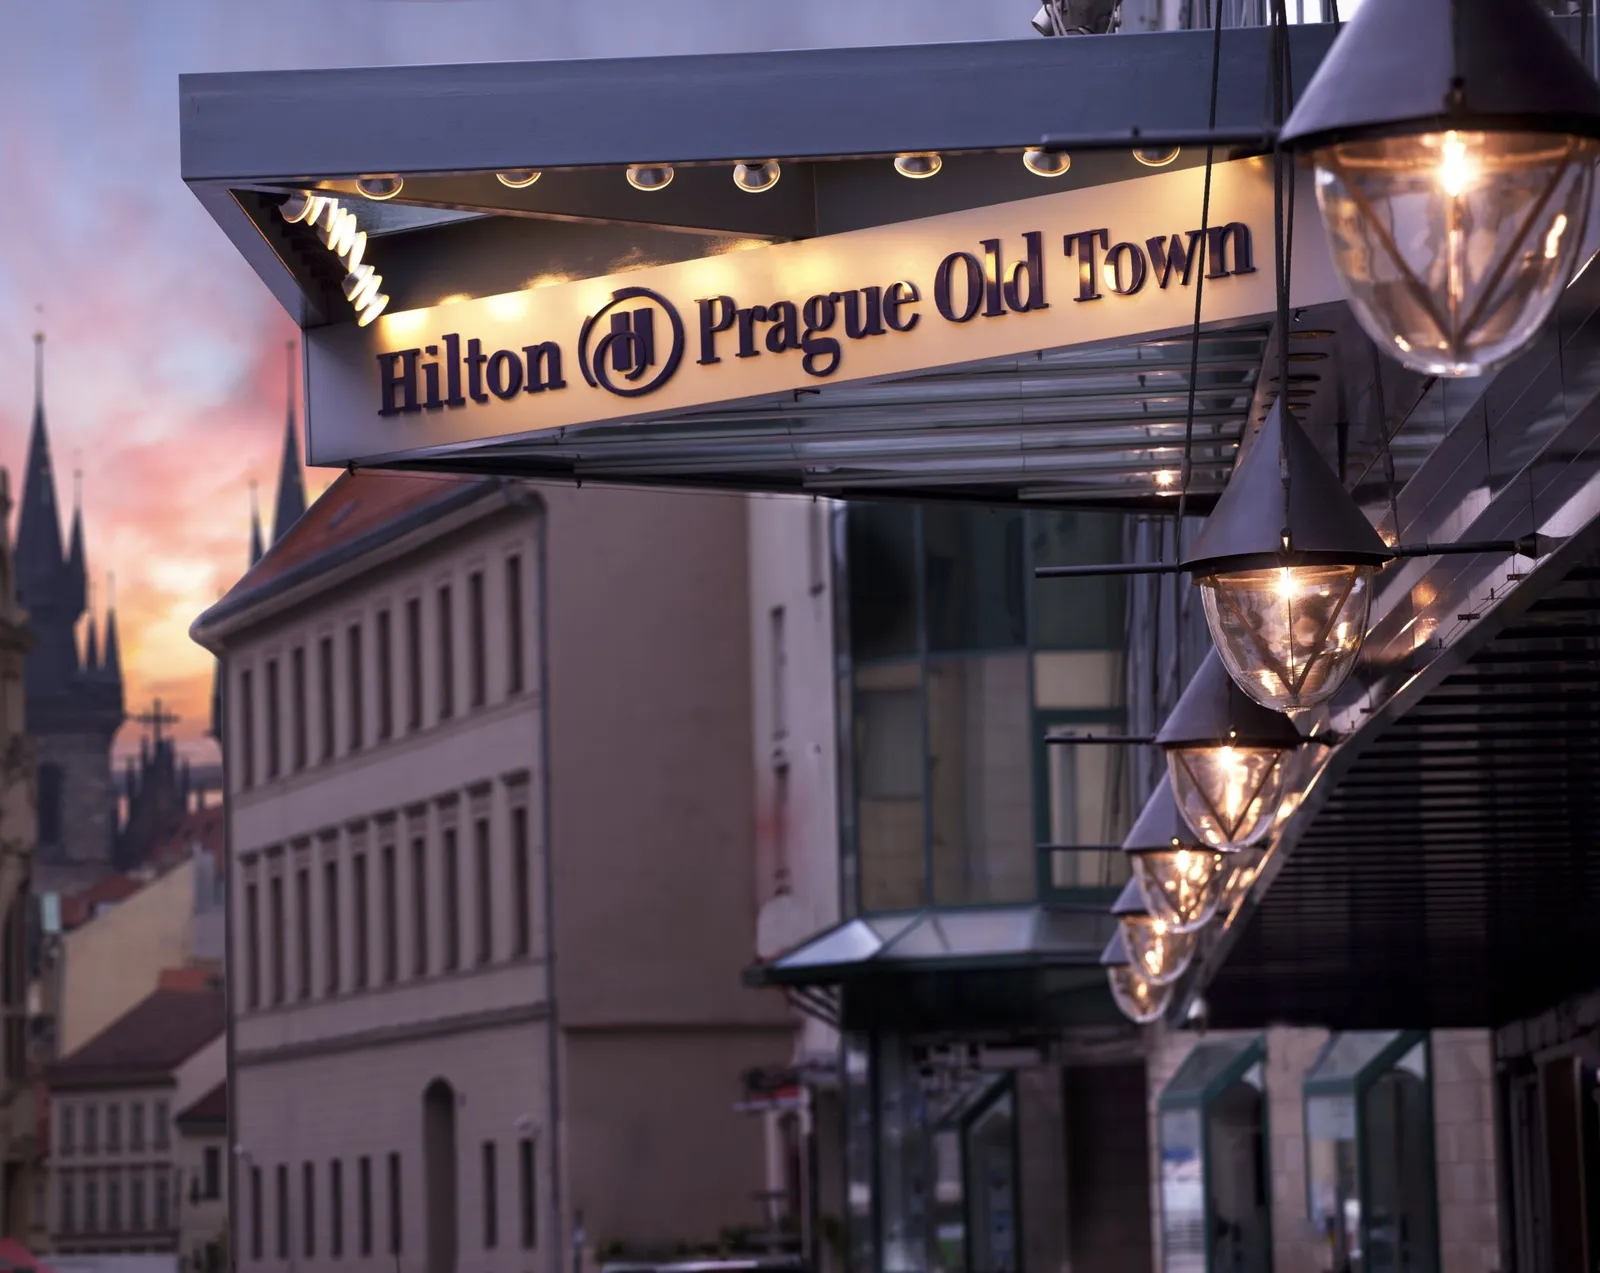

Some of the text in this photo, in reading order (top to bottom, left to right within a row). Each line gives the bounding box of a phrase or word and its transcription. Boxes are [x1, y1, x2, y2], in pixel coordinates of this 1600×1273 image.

[377, 333, 566, 416] Hilton
[695, 280, 920, 377] Prague
[934, 231, 1049, 323] Old
[1063, 221, 1256, 302] Town
